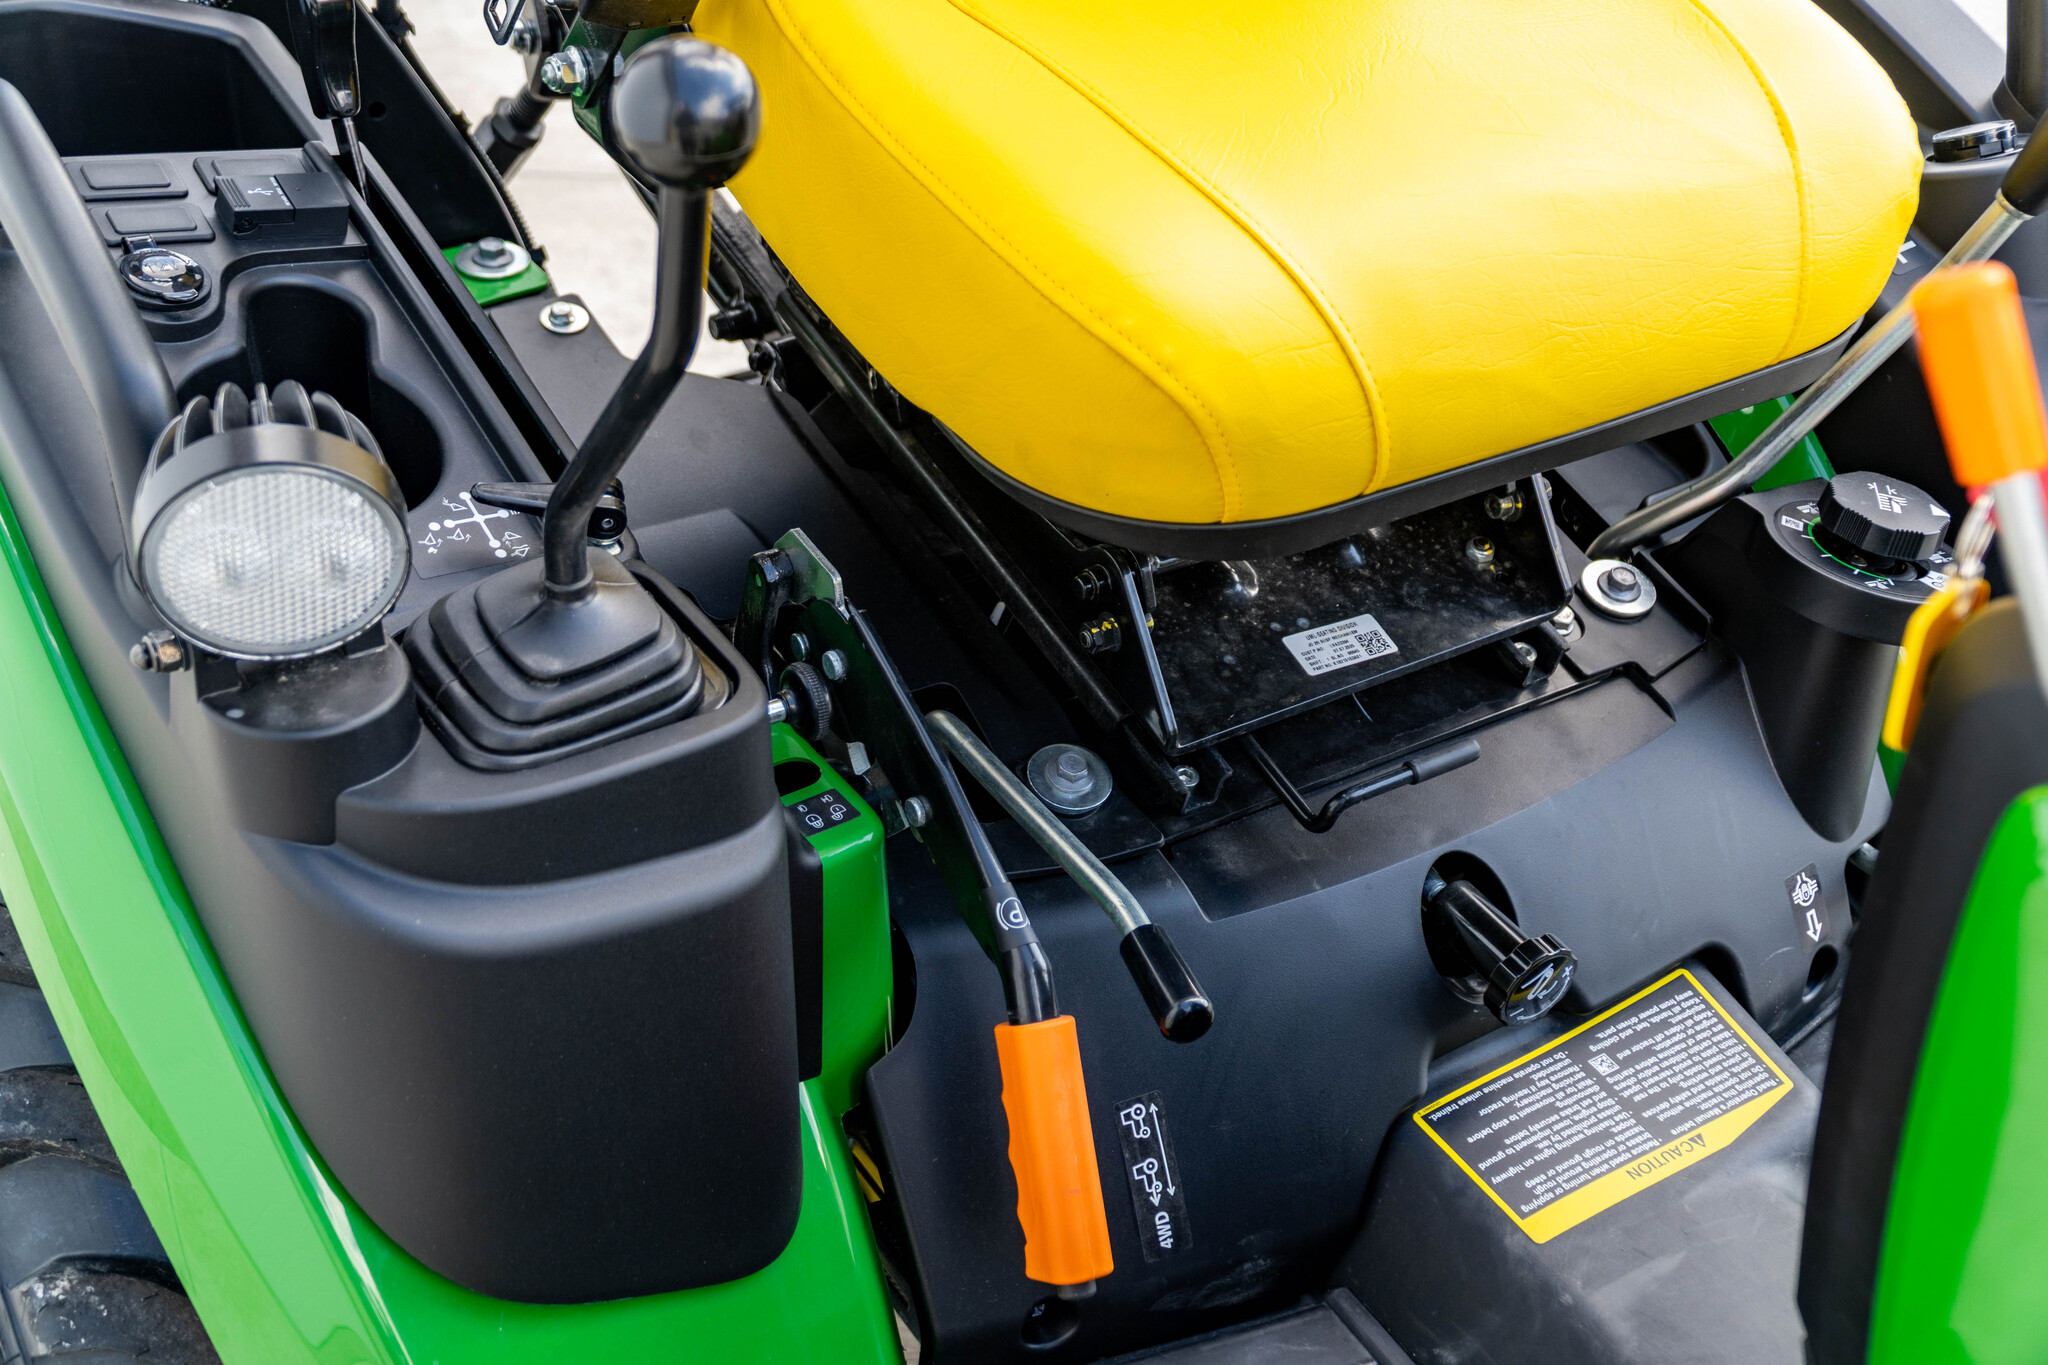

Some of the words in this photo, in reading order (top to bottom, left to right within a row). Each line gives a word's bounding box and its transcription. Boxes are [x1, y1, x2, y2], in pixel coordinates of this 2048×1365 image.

[144, 259, 179, 274] 12V
[1675, 991, 1693, 1001] away
[1681, 997, 1701, 1008] Keep
[1659, 999, 1677, 1009] from
[1638, 1005, 1660, 1019] power
[1647, 1010, 1674, 1023] hands,
[1668, 1004, 1705, 1024] equipment.
[1693, 1011, 1713, 1021] Keep
[1616, 1017, 1638, 1029] driven
[1632, 1021, 1650, 1031] feet,
[1664, 1024, 1685, 1035] riders
[1684, 1019, 1694, 1027] all
[1694, 1017, 1718, 1031] engine
[1712, 1024, 1724, 1032] are
[1596, 1026, 1617, 1038] parts.
[1619, 1029, 1633, 1039] and
[1654, 1033, 1665, 1042] off
[1695, 1030, 1712, 1041] clear
[1711, 1031, 1732, 1042] Make
[1589, 1036, 1619, 1052] clothing
[1631, 1038, 1655, 1052] tractor
[1652, 1033, 1686, 1050] operation.
[1686, 1038, 1695, 1046] of
[1687, 1040, 1712, 1054] certain
[1718, 1038, 1738, 1049] hitch
[1616, 1050, 1631, 1060] and
[1657, 1042, 1687, 1059] machine
[1701, 1045, 1719, 1057] plate
[1724, 1045, 1744, 1056] Hitch
[1540, 1057, 1554, 1066] not
[1635, 1057, 1659, 1070] before
[1659, 1052, 1688, 1068] children
[1673, 1060, 1693, 1072] avoid
[1703, 1054, 1726, 1068] towed
[1722, 1054, 1742, 1067] place
[1729, 1057, 1756, 1073] guards,
[1513, 1063, 1541, 1078] operate
[1530, 1059, 1572, 1083] unattended.
[1549, 1065, 1580, 1081] Remove
[1606, 1068, 1635, 1083] starting
[1637, 1065, 1660, 1079] and/or
[1683, 1064, 1705, 1076] loads
[1708, 1065, 1723, 1075] and
[1738, 1071, 1752, 1080] not
[1751, 1065, 1764, 1073] Do
[1483, 1076, 1514, 1093] machine
[1536, 1079, 1551, 1088] key
[1551, 1072, 1586, 1090] servicing
[1576, 1079, 1594, 1089] Wait
[1613, 1077, 1637, 1090] others
[1642, 1069, 1674, 1088] rearward
[1668, 1074, 1684, 1084] only
[1679, 1072, 1709, 1088] working.
[1705, 1071, 1730, 1086] shields
[1713, 1077, 1739, 1092] operate
[1735, 1072, 1769, 1091] operating
[1756, 1079, 1777, 1092] Read
[1502, 1088, 1531, 1103] leaving
[1555, 1091, 1565, 1100] all
[1565, 1086, 1577, 1094] for
[1619, 1084, 1643, 1098] upset.
[1647, 1086, 1661, 1094] the
[1691, 1084, 1705, 1094] and
[1722, 1089, 1738, 1098] this
[1458, 1091, 1483, 1105] unless
[1514, 1087, 1553, 1108] machinery.
[1555, 1085, 1600, 1108] dismounting.
[1580, 1099, 1593, 1107] set
[1592, 1091, 1607, 1102] and
[1597, 1098, 1615, 1109] Stop
[1633, 1092, 1648, 1102] rear
[1669, 1091, 1691, 1104] safety
[1684, 1090, 1714, 1107] machine
[1697, 1096, 1724, 1110] tractor.
[1720, 1089, 1758, 1110] Operator's
[1429, 1104, 1459, 1121] trained.
[1479, 1101, 1504, 1116] tractor
[1517, 1096, 1558, 1117] movement
[1559, 1104, 1584, 1117] brake
[1570, 1106, 1597, 1120] engine,
[1597, 1105, 1622, 1119] unless
[1642, 1102, 1670, 1117] devices
[1657, 1105, 1685, 1121] without
[1614, 1112, 1630, 1121] Use
[1694, 1107, 1722, 1124] Manual
[1492, 1119, 1509, 1130] stop
[1528, 1114, 1560, 1132] securely
[1552, 1119, 1573, 1131] lower
[1560, 1115, 1598, 1138] prohibited
[1583, 1119, 1615, 1136] flashing
[1609, 1118, 1636, 1133] slopes.
[1671, 1121, 1696, 1135] before
[1467, 1128, 1493, 1143] before
[1504, 1130, 1530, 1144] before
[1514, 1129, 1553, 1151] implement
[1550, 1134, 1563, 1142] by
[1615, 1125, 1645, 1141] hazards
[1626, 1132, 1652, 1147] brakes
[1535, 1140, 1552, 1149] law.
[1554, 1133, 1586, 1150] warning
[1631, 1139, 1660, 1155] Reduce
[1534, 1148, 1557, 1161] lights
[1582, 1144, 1605, 1158] rough
[1478, 1151, 1506, 1170] ground
[1523, 1159, 1534, 1167] on
[1555, 1154, 1583, 1173] ground
[1581, 1149, 1617, 1169] operating
[1609, 1153, 1632, 1167] speed
[1625, 1141, 1694, 1181] CAUTION
[1492, 1164, 1525, 1184] highway
[1547, 1169, 1556, 1177] or
[1556, 1166, 1583, 1184] around
[1589, 1163, 1610, 1176] when
[1525, 1174, 1547, 1188] steep
[1533, 1180, 1557, 1194] rough
[1561, 1173, 1591, 1190] turning
[1521, 1192, 1554, 1212] applying
[1155, 1211, 1174, 1249] 4WD
